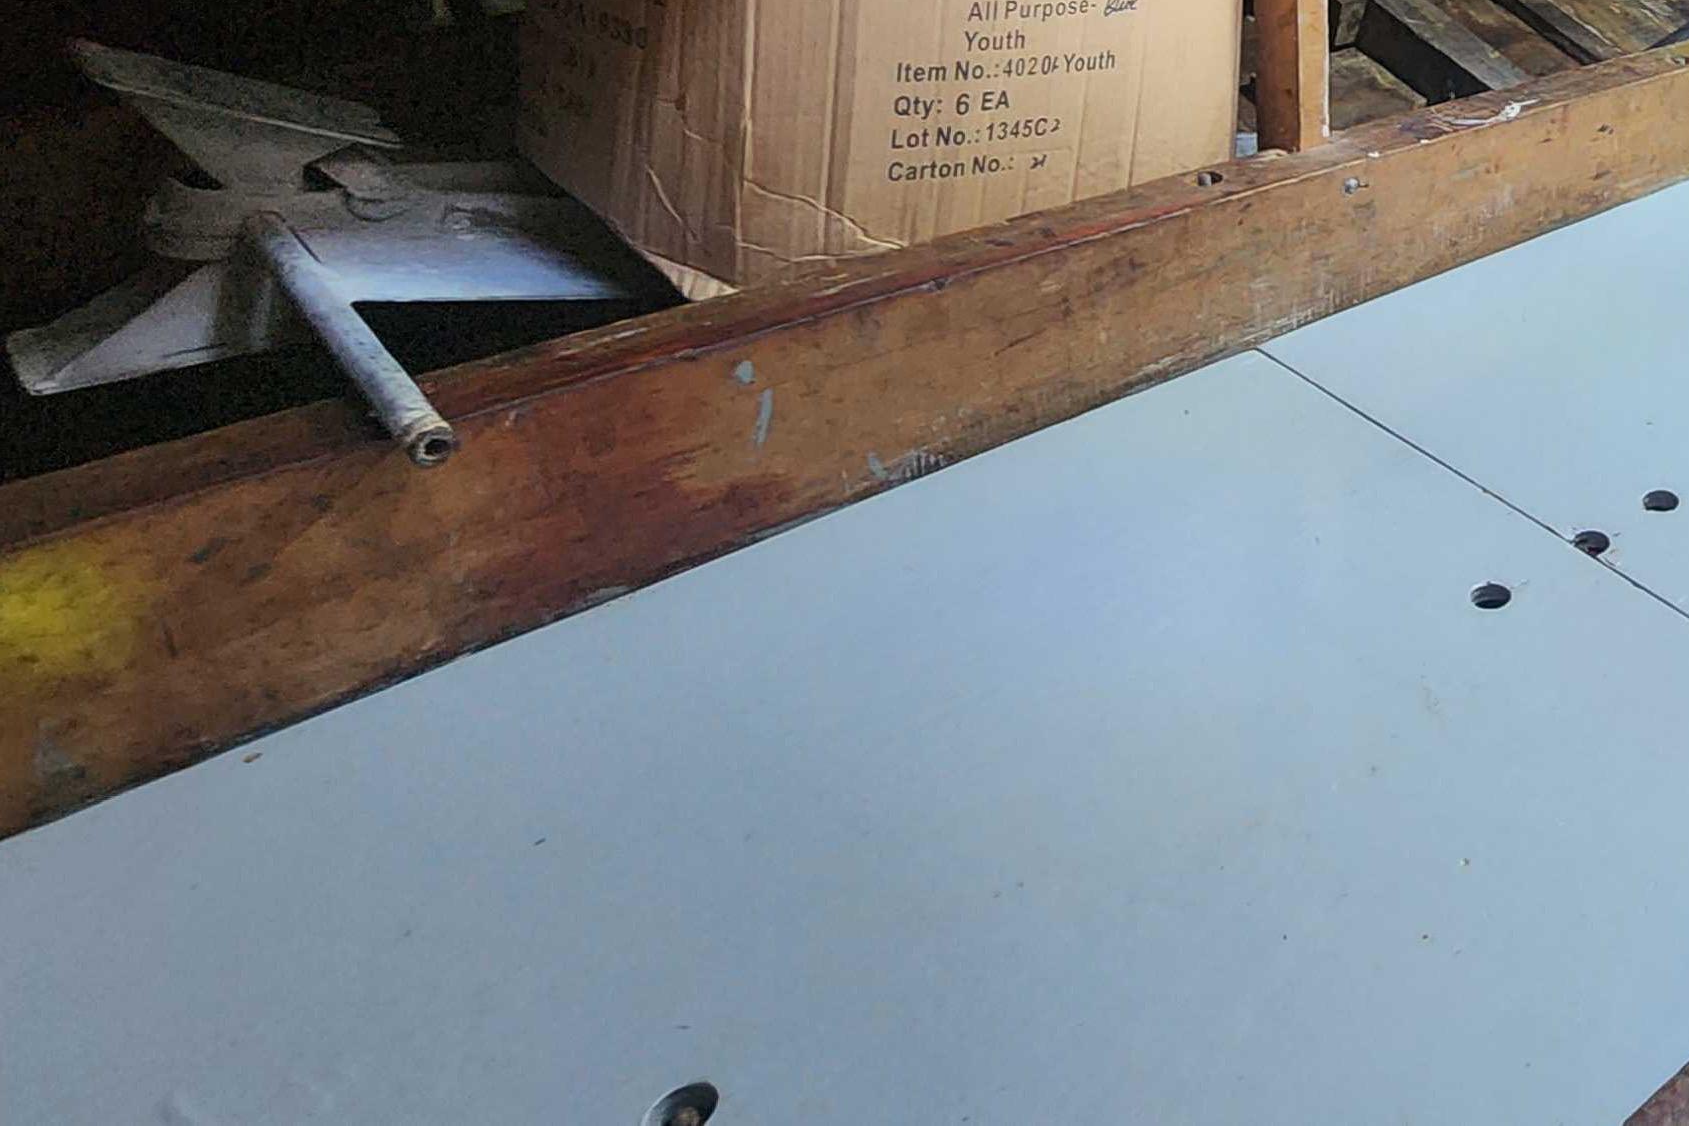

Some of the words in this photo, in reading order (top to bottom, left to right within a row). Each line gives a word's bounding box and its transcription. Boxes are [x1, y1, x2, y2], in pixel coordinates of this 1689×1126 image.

[967, 1, 998, 22] All
[964, 29, 1027, 52] Youth
[895, 62, 948, 83] Item
[893, 94, 944, 120] Qty:
[955, 93, 971, 116] 6
[980, 90, 1011, 112] EA
[891, 127, 930, 150] Lot
[887, 158, 965, 183] Carton
[972, 152, 1015, 176] No.:
